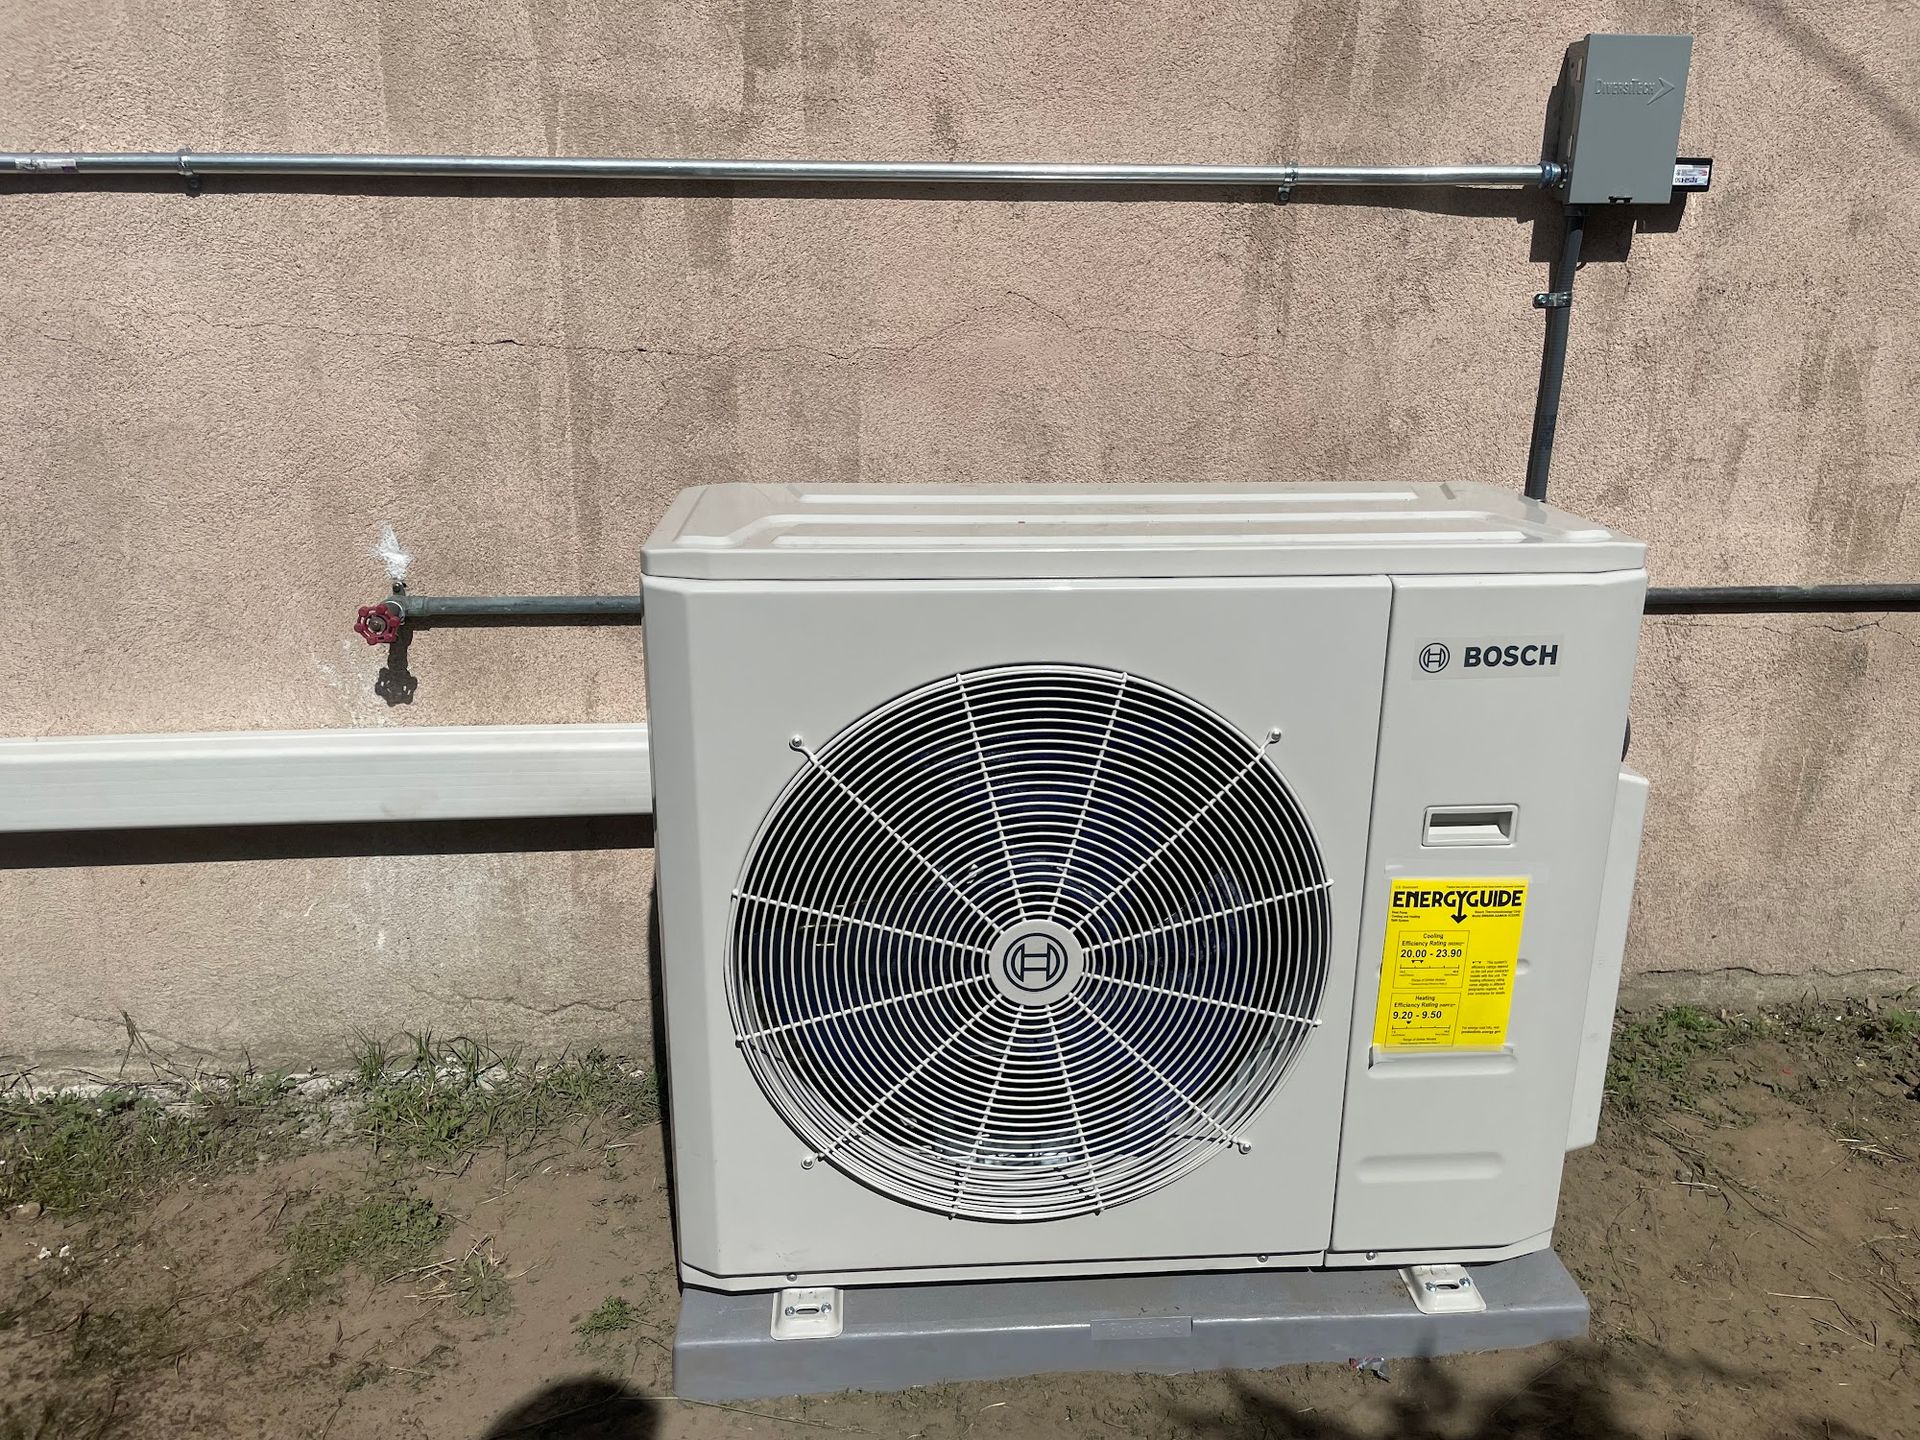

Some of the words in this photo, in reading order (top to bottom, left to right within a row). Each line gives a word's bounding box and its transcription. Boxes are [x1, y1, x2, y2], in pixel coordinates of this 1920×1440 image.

[1463, 644, 1558, 668] BOSCH
[1393, 890, 1523, 908] ENERGYGUIDE
[1400, 949, 1427, 958] 20.00
[1436, 949, 1462, 958] 23.90
[1392, 1011, 1413, 1020] 9.20
[1421, 1010, 1442, 1019] 9.50
